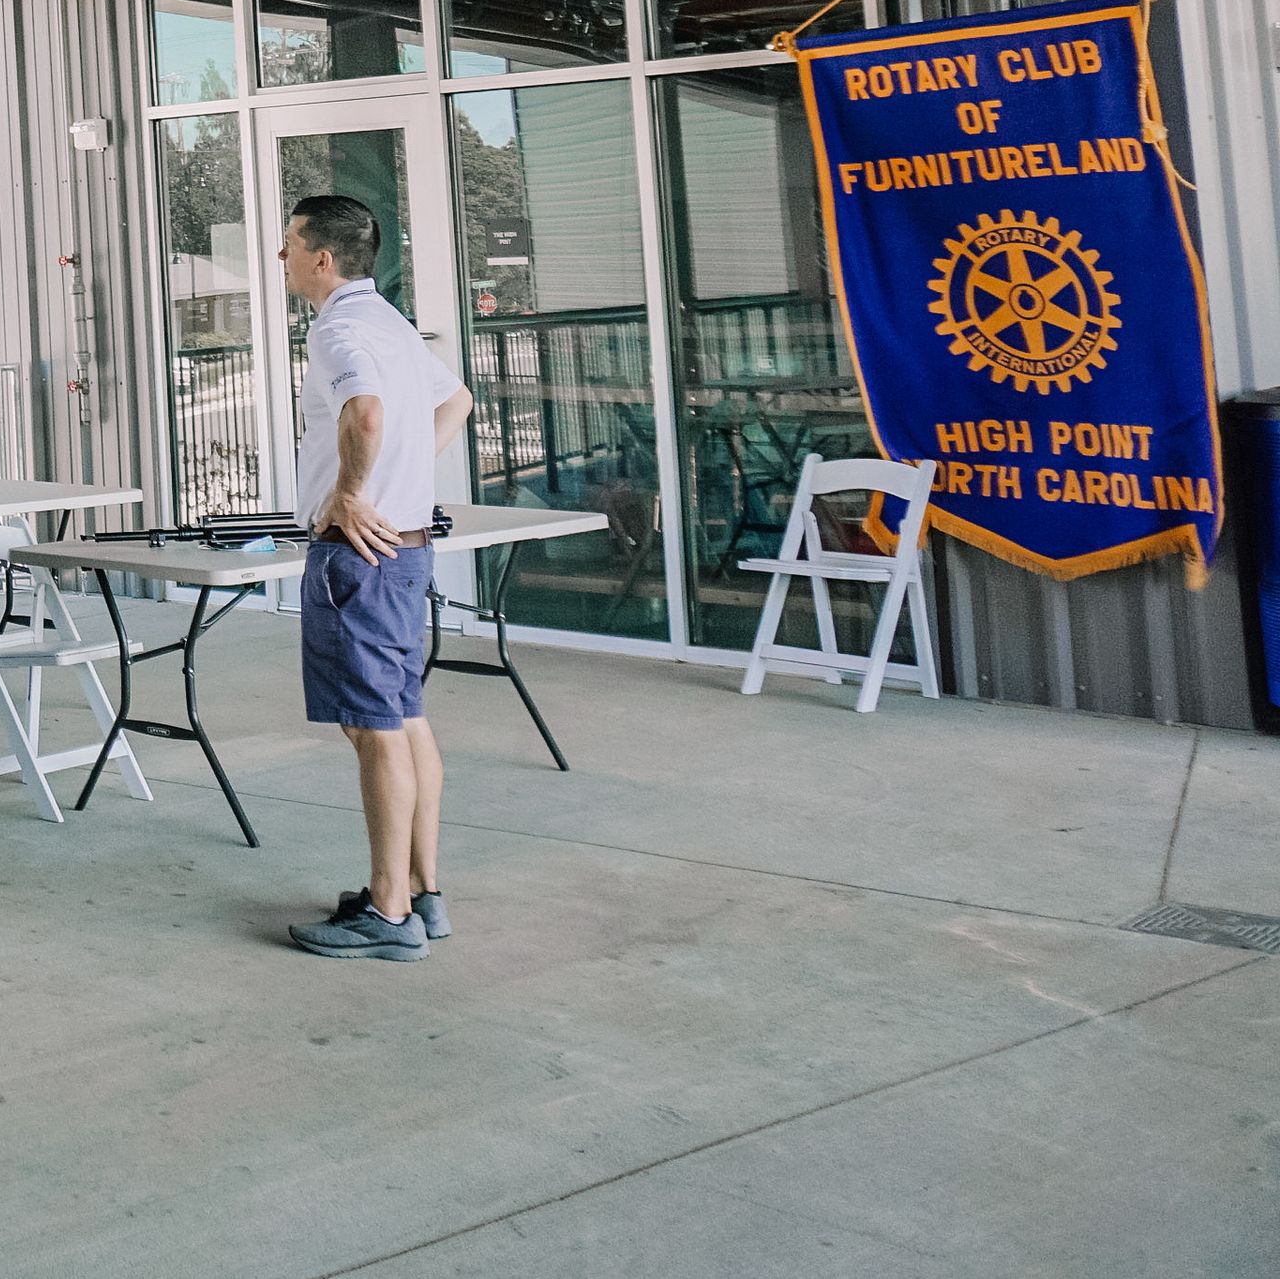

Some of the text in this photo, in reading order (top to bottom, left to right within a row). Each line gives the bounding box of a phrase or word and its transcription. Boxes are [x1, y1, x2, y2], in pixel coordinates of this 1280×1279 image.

[845, 39, 1102, 101] ROTARY CLUB
[957, 99, 1003, 135] OF
[839, 137, 1146, 194] FURNITURELAND
[974, 229, 1051, 252] ROTARY
[967, 331, 1099, 375] INTERNATIONAL
[937, 419, 1154, 462] HIGH POINT
[901, 458, 1214, 514] ORTH CAROLINA
